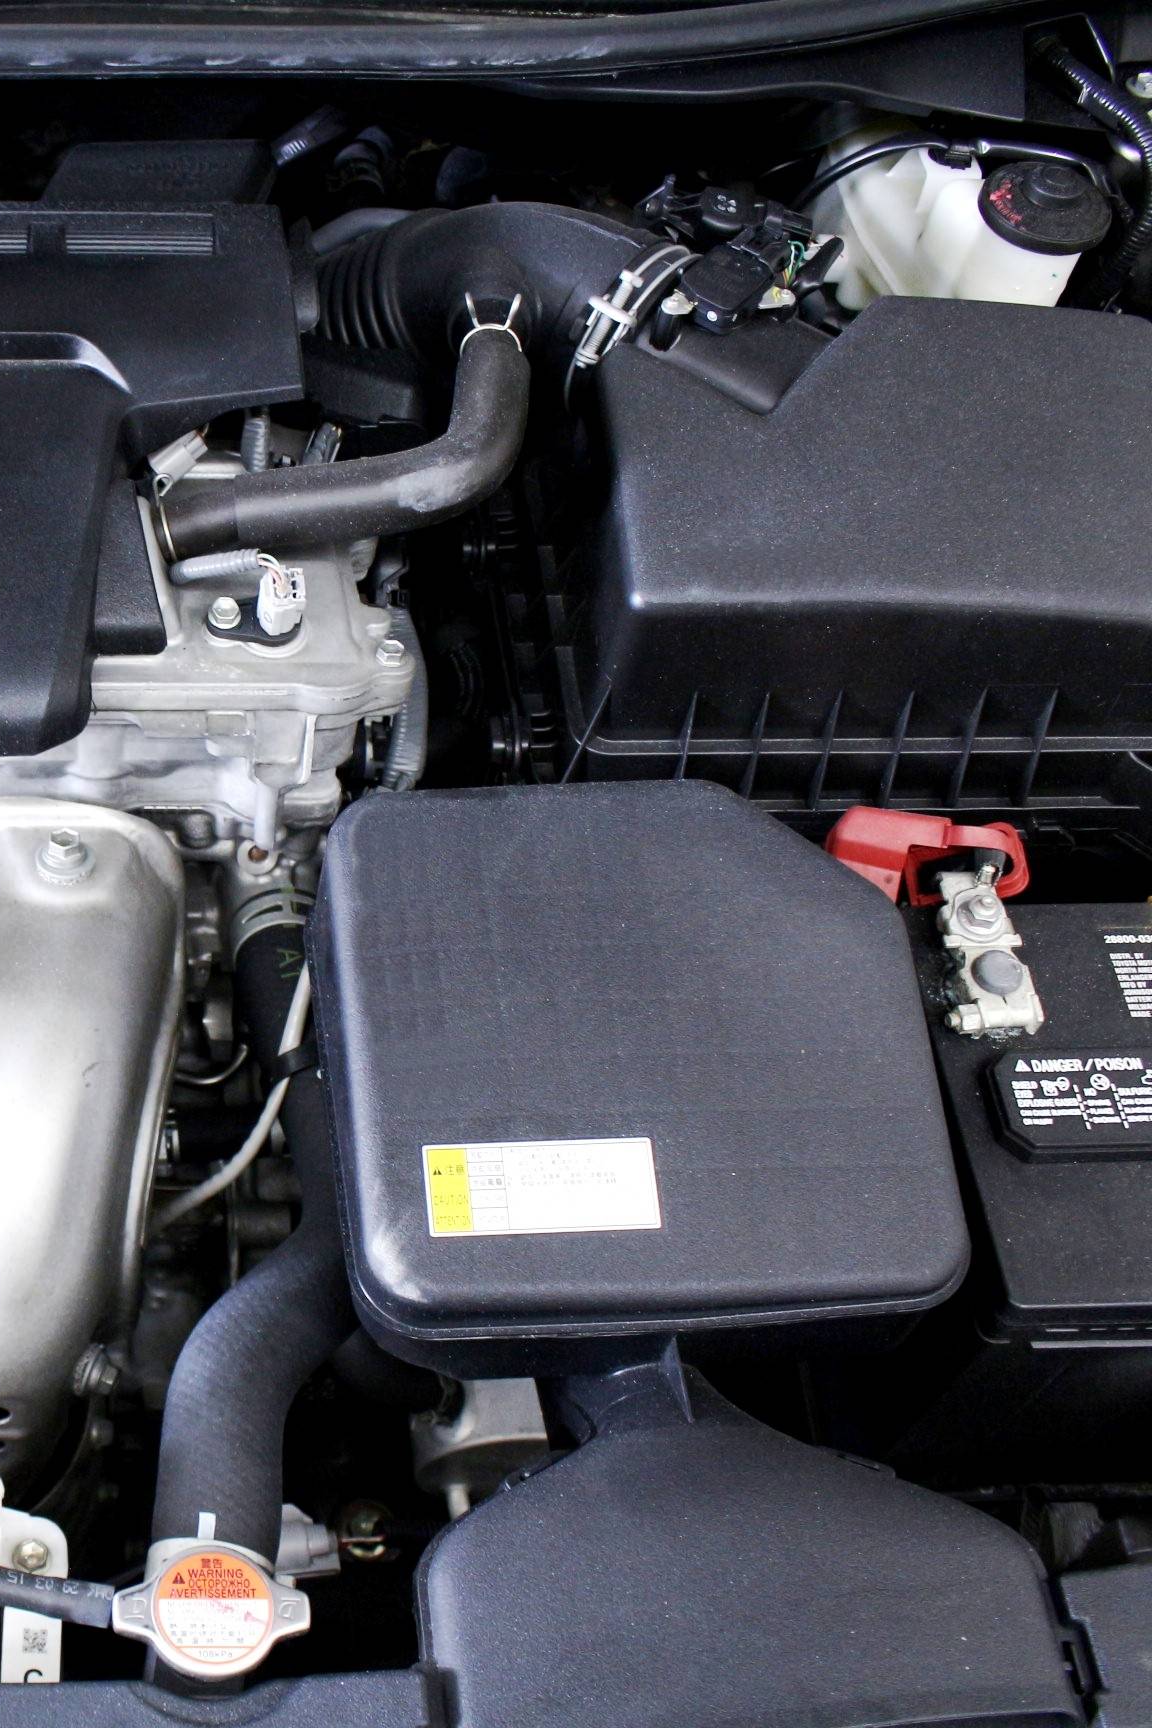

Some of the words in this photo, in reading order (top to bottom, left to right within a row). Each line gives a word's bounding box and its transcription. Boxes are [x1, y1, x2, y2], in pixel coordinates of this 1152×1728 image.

[1104, 934, 1152, 944] 28800-03
[6, 1570, 24, 1585] 15
[187, 1568, 244, 1579] WARNING
[169, 1588, 257, 1599] AVERTISSEMENT
